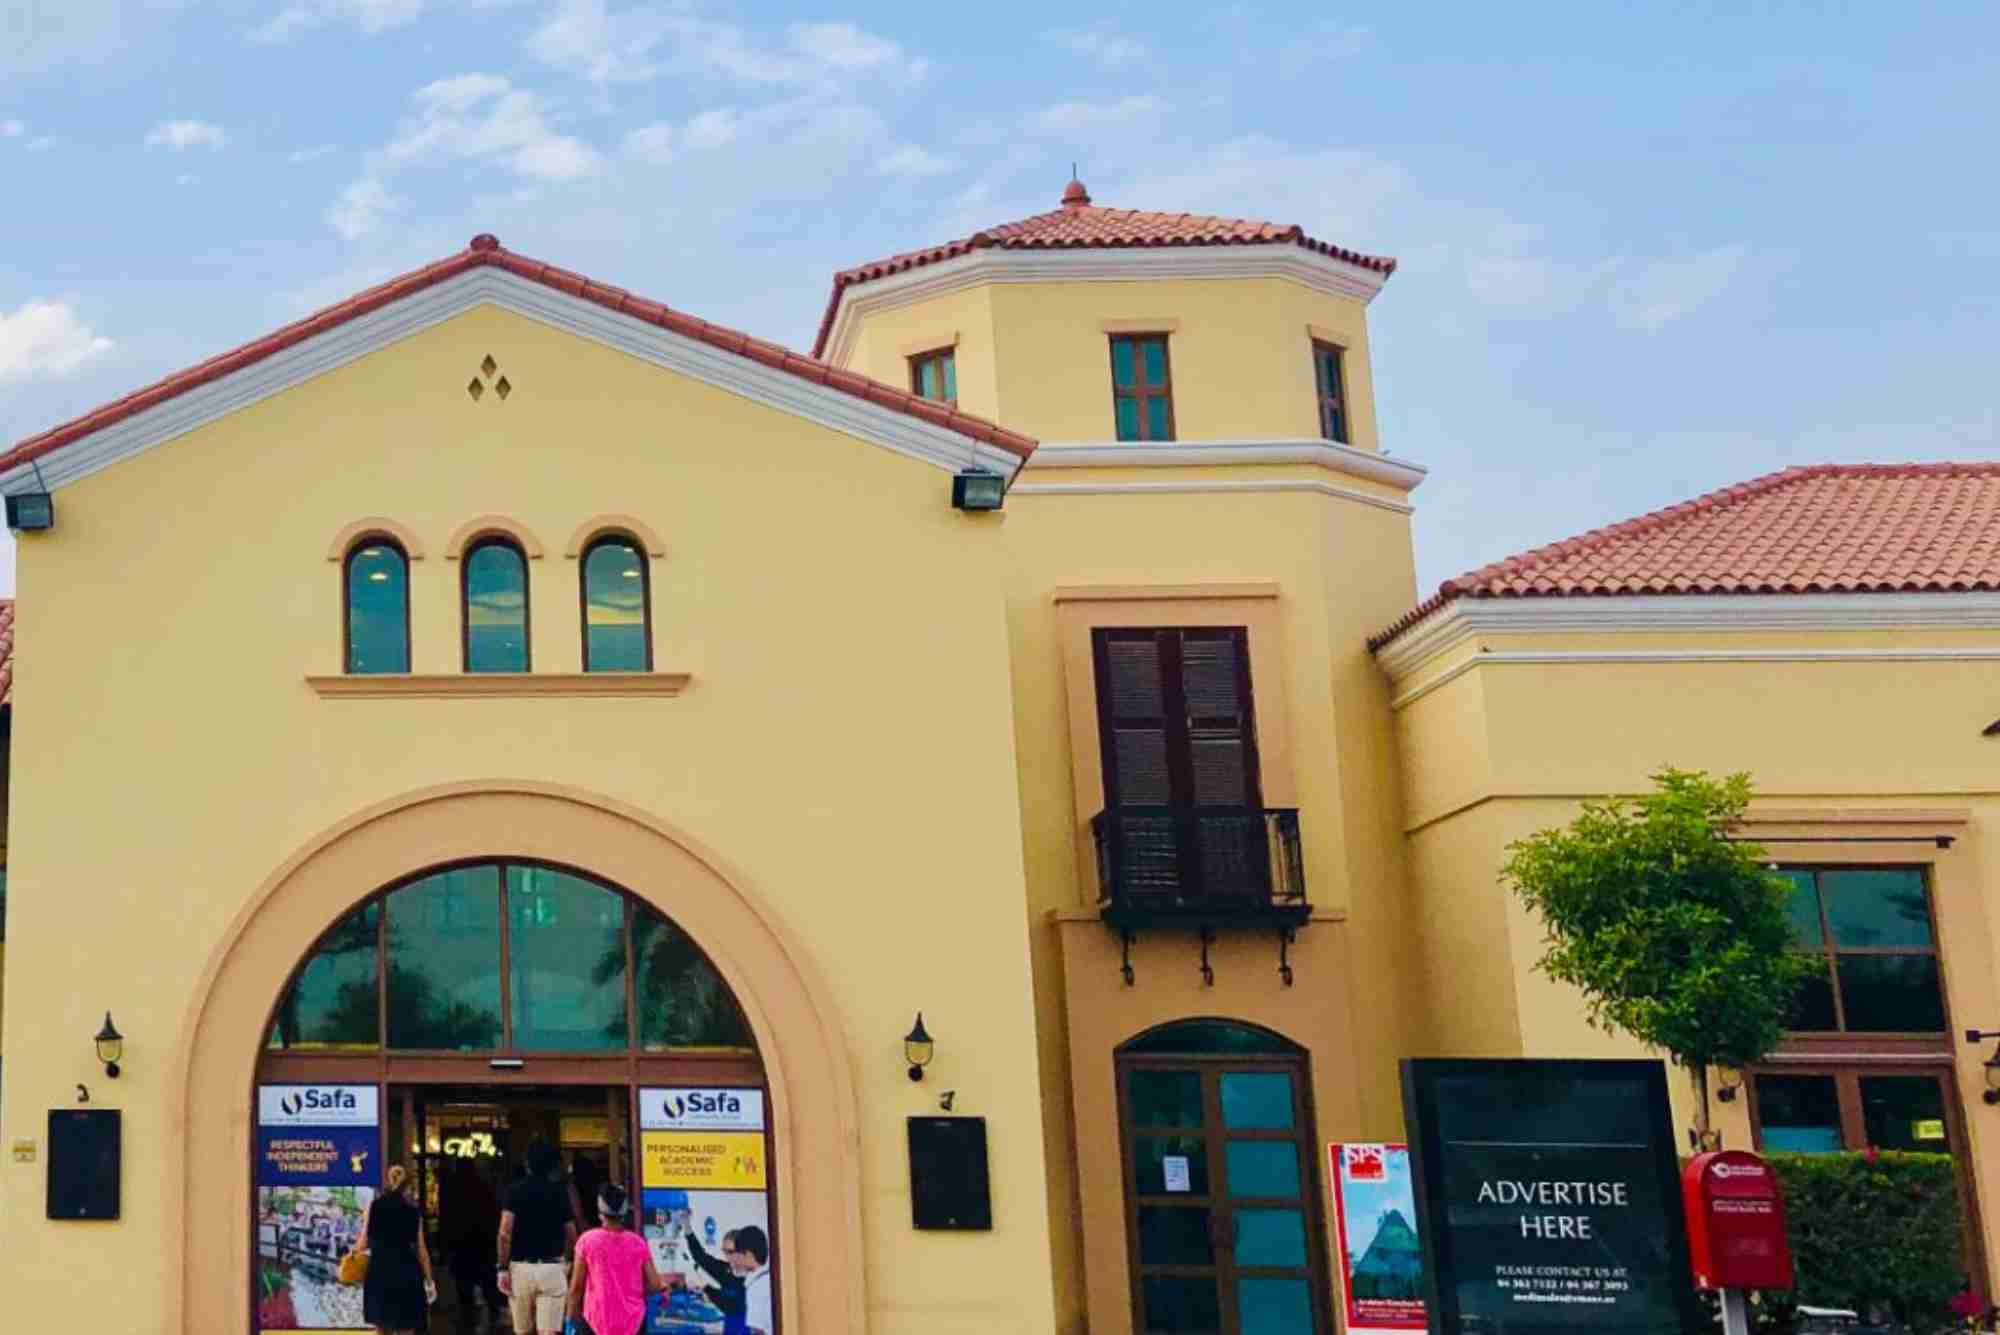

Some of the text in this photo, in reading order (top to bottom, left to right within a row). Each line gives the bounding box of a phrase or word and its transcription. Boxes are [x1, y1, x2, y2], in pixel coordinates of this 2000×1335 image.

[305, 1089, 356, 1108] Safa
[687, 1092, 740, 1112] Safa
[270, 1140, 335, 1150] RESPECTFUL
[646, 1144, 727, 1154] PERSONALISED
[266, 1151, 338, 1161] INDEPENDENT
[658, 1156, 715, 1165] ACADEMIC
[279, 1162, 329, 1172] THINKERS
[663, 1167, 712, 1176] SUCCESS
[1477, 1181, 1628, 1206] ADVERTISE
[1520, 1214, 1592, 1240] HERE
[1495, 1265, 1533, 1276] PLEASE
[1536, 1266, 1591, 1278] CONTACT
[1594, 1267, 1610, 1278] US
